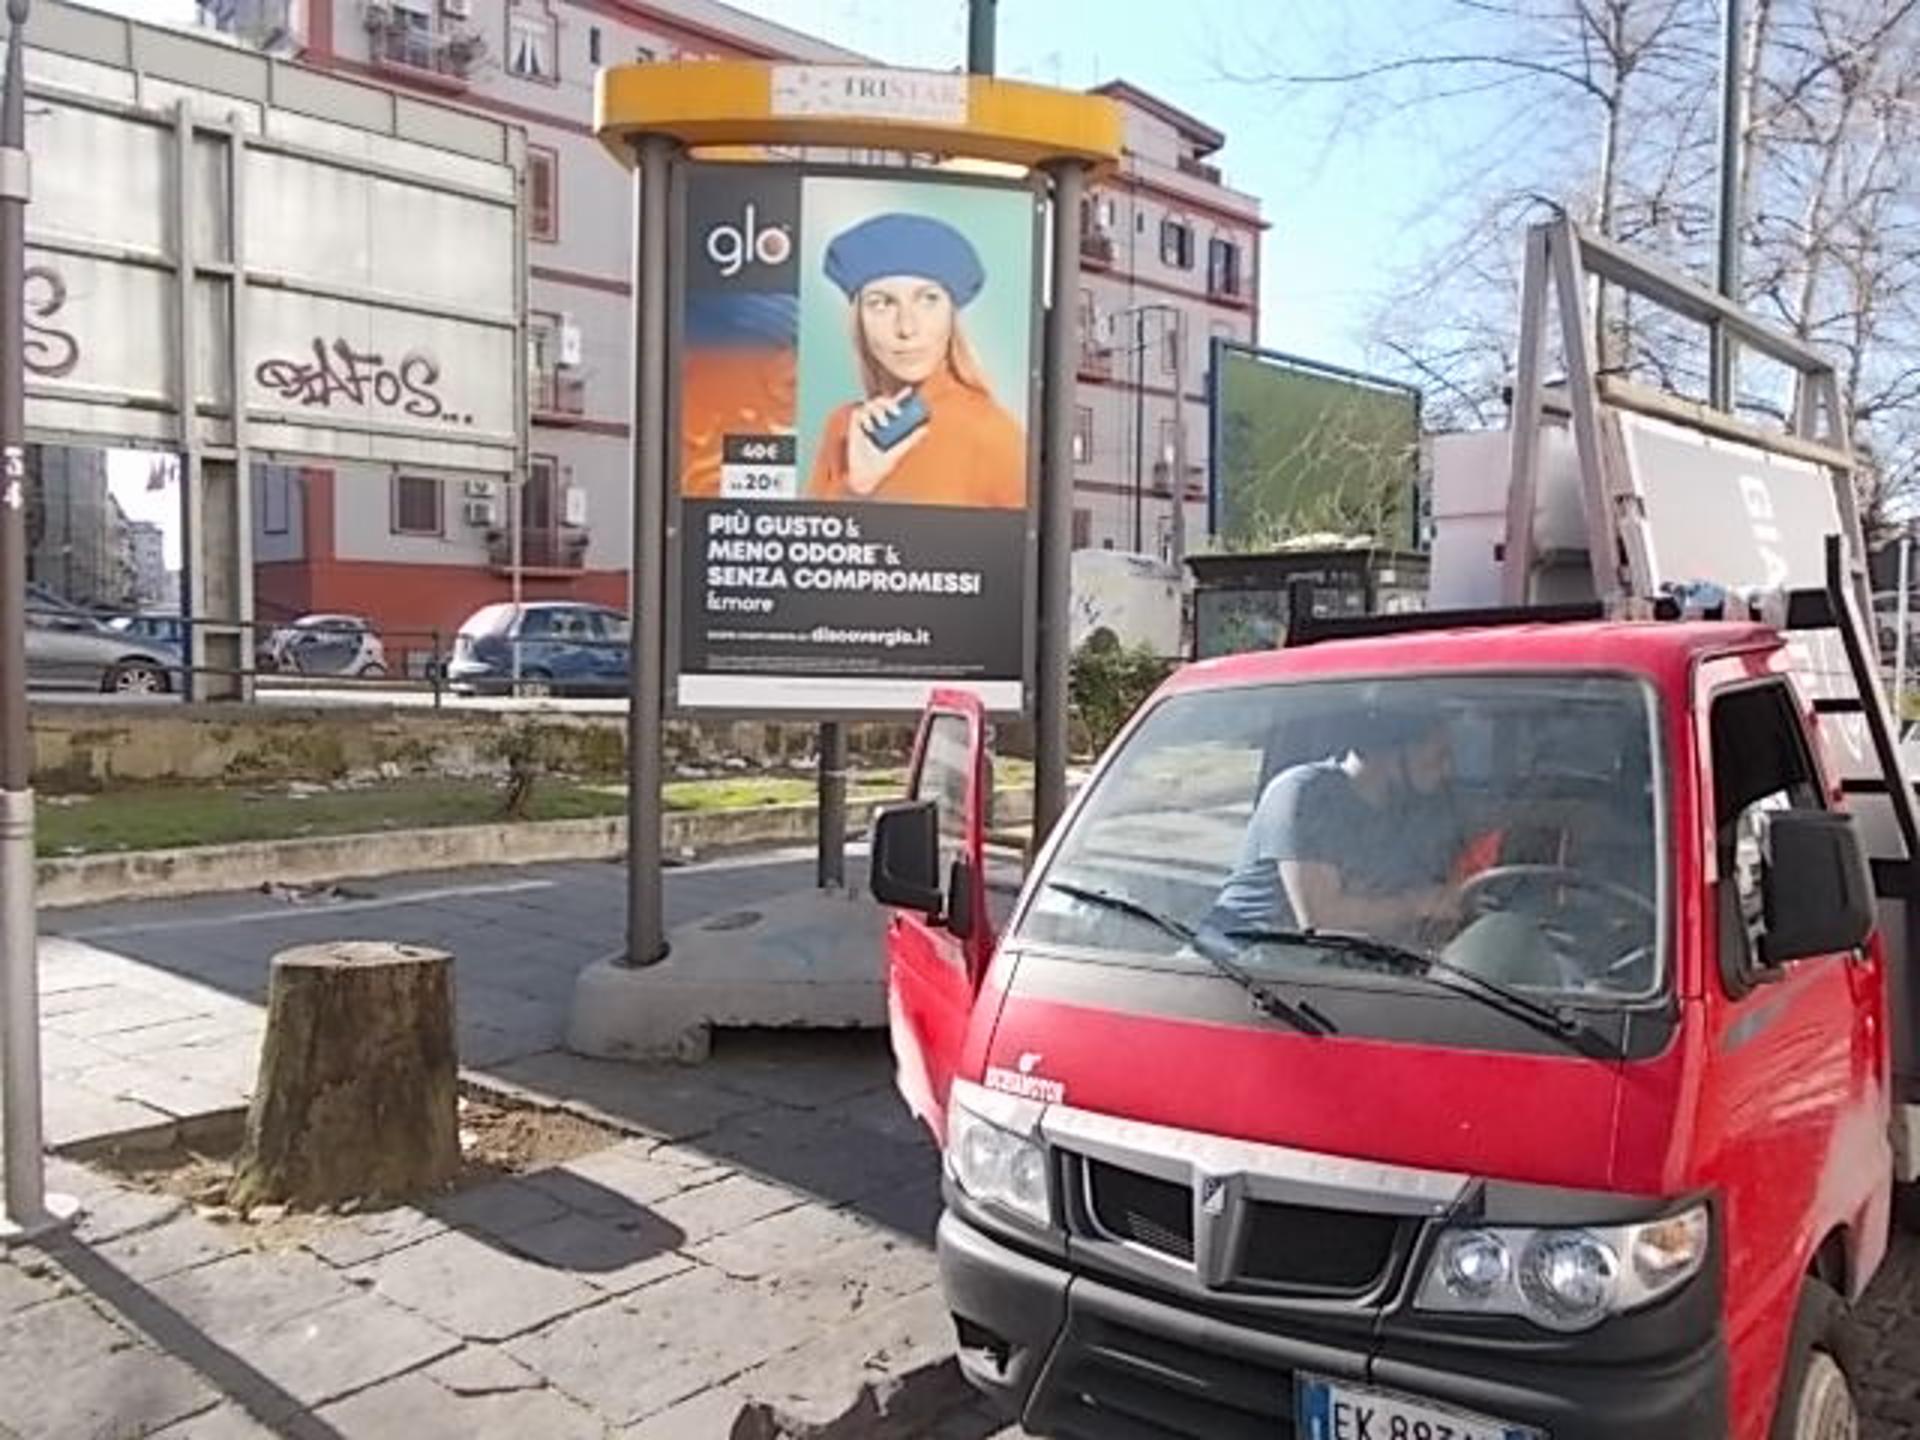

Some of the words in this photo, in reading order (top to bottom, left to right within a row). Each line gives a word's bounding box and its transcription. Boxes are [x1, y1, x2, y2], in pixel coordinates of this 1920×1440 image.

[707, 203, 791, 276] glo
[709, 509, 750, 535] PIÙ
[755, 515, 842, 537] GUSTO
[708, 540, 784, 561] MENO
[788, 542, 876, 565] ODORE
[708, 566, 788, 588] SENZA
[794, 568, 981, 594] COMPROMESSI
